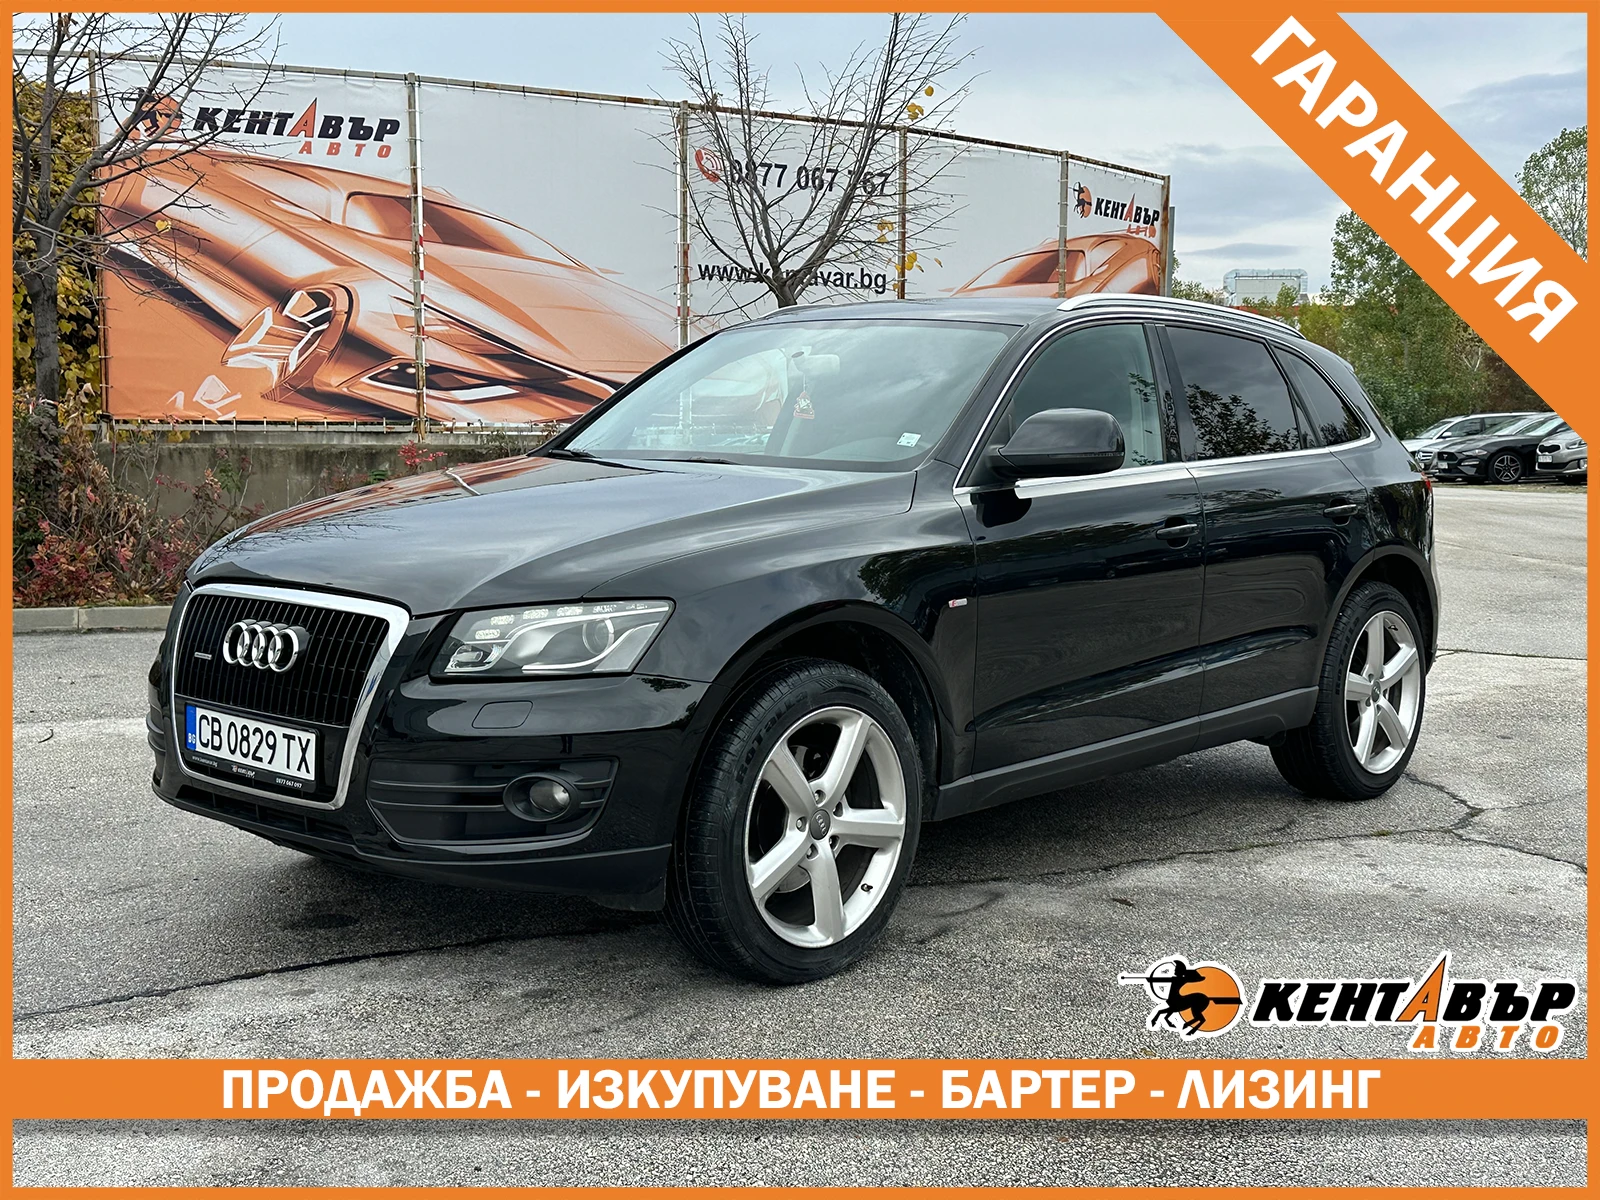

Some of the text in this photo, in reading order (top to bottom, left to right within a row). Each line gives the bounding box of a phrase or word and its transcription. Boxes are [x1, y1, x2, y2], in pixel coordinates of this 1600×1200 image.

[194, 97, 401, 142] КЕНТАВЪР
[298, 141, 393, 159] АВТО
[796, 165, 839, 192] 067
[847, 169, 890, 195] 67
[1094, 193, 1160, 226] КЕНТАВЪР
[199, 714, 311, 775] CB 0829 TX
